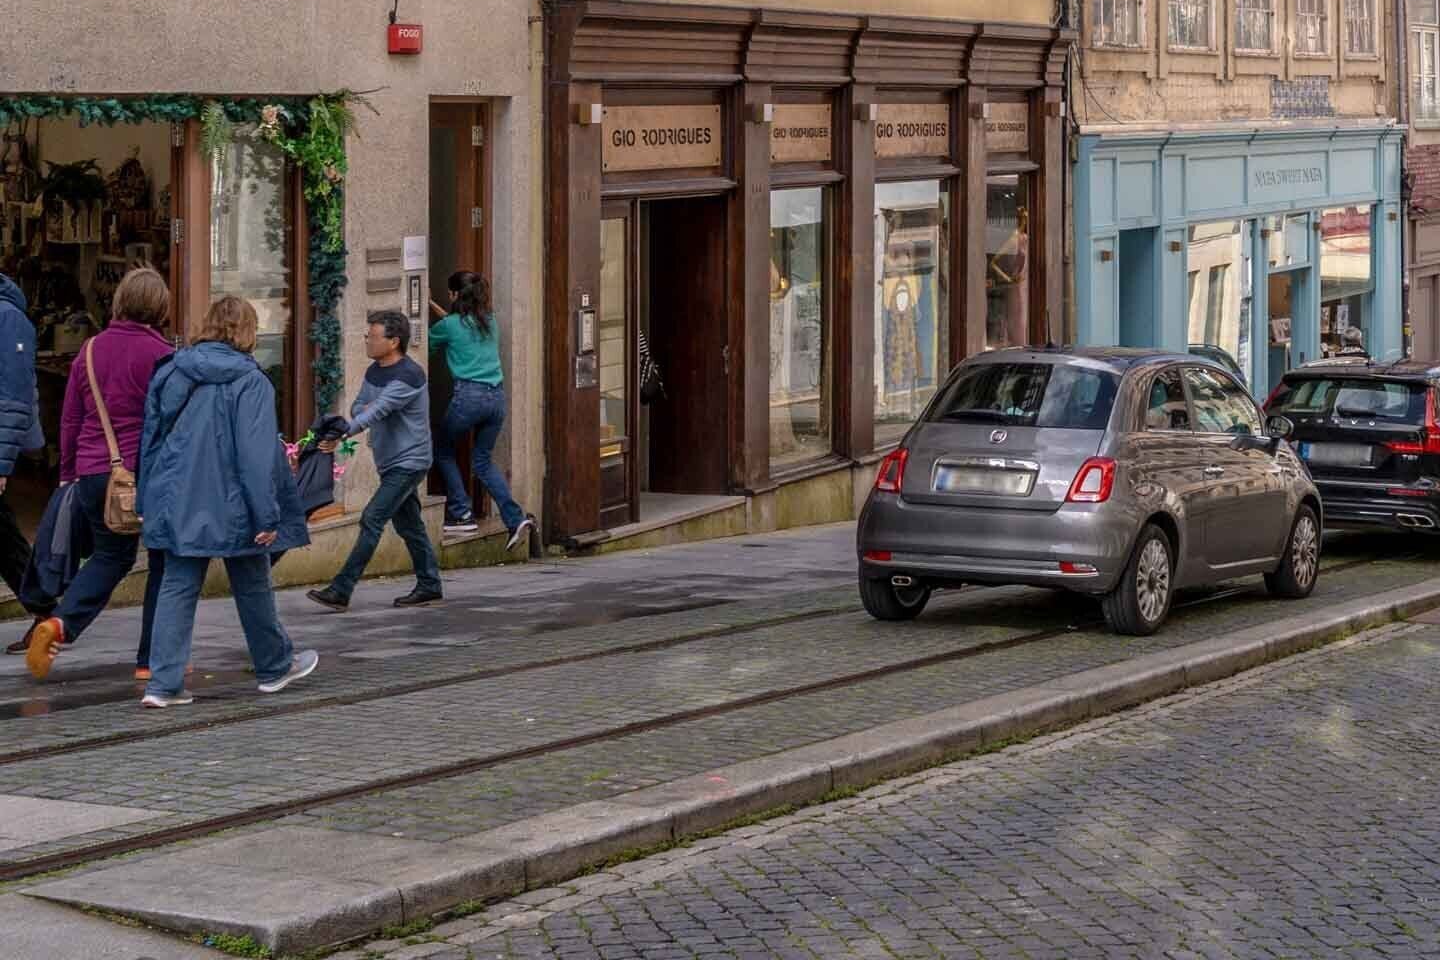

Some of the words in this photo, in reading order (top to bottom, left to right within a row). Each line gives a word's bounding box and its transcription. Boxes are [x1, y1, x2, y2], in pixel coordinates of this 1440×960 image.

[399, 28, 420, 38] FOGO
[772, 128, 786, 138] GIO
[789, 127, 829, 138] RODRIGUES
[876, 124, 893, 138] GIO
[897, 122, 947, 137] RODRIGUES
[612, 130, 636, 147] GIO
[642, 127, 712, 146] RODRIGUES
